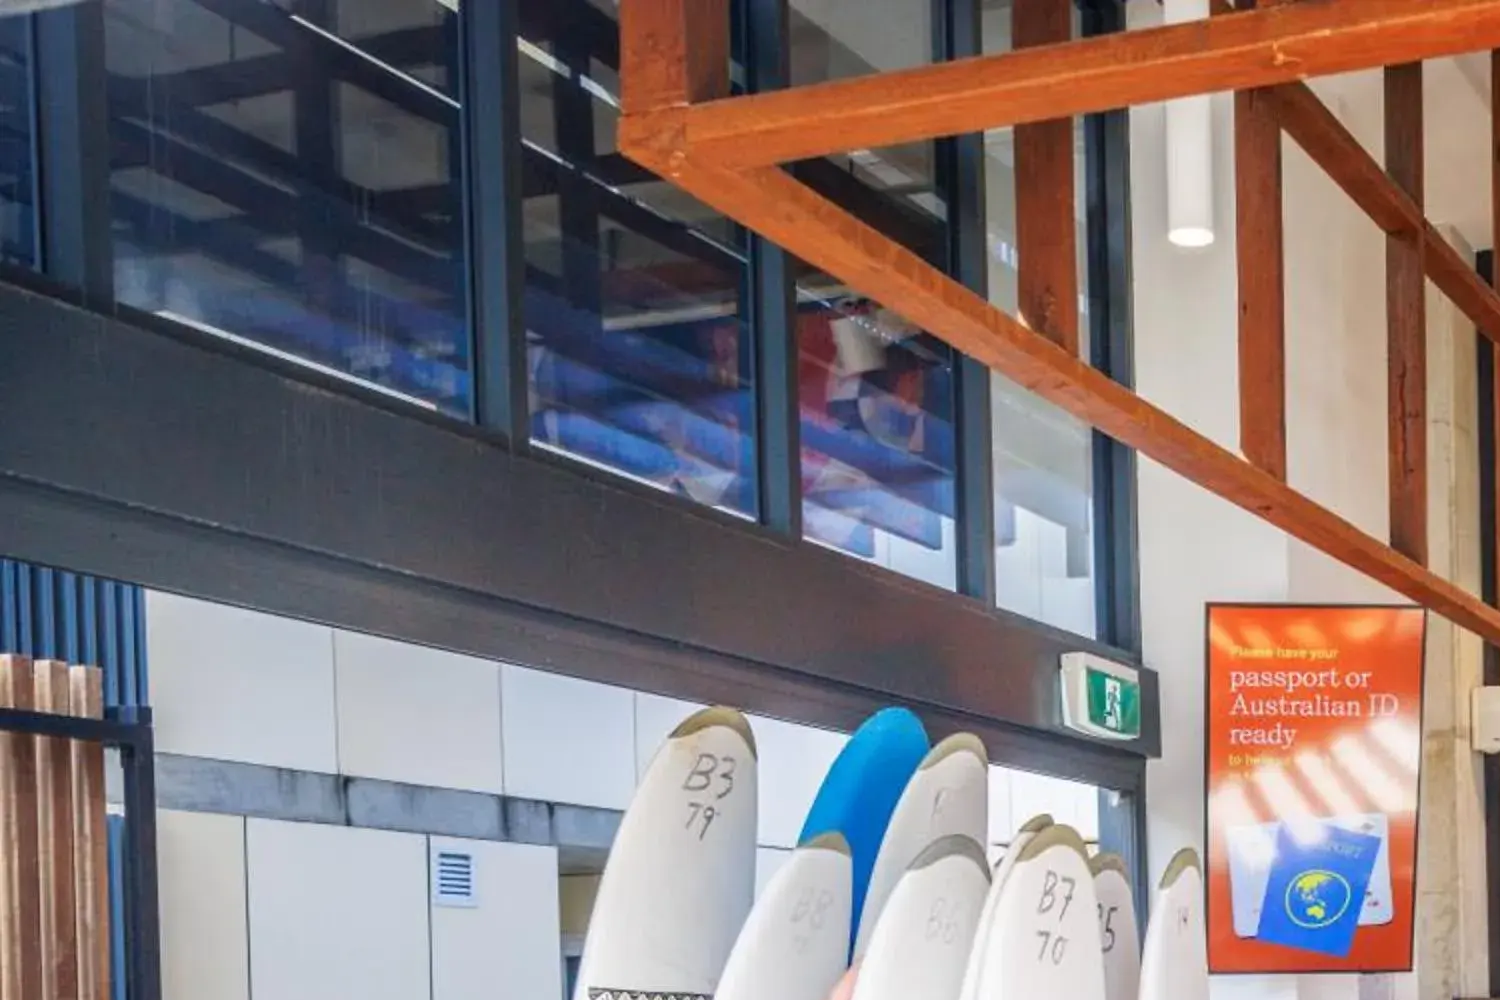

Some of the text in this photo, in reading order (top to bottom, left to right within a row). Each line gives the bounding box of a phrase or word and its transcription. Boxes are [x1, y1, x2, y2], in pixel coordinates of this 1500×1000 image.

[1276, 646, 1306, 659] have
[1310, 649, 1339, 661] your
[1229, 667, 1373, 693] passport or
[1229, 693, 1399, 717] Australian ID
[1229, 722, 1297, 749] ready
[681, 752, 737, 800] B3
[684, 801, 716, 842] 79
[1037, 869, 1076, 922] B7
[1036, 929, 1070, 967] 70
